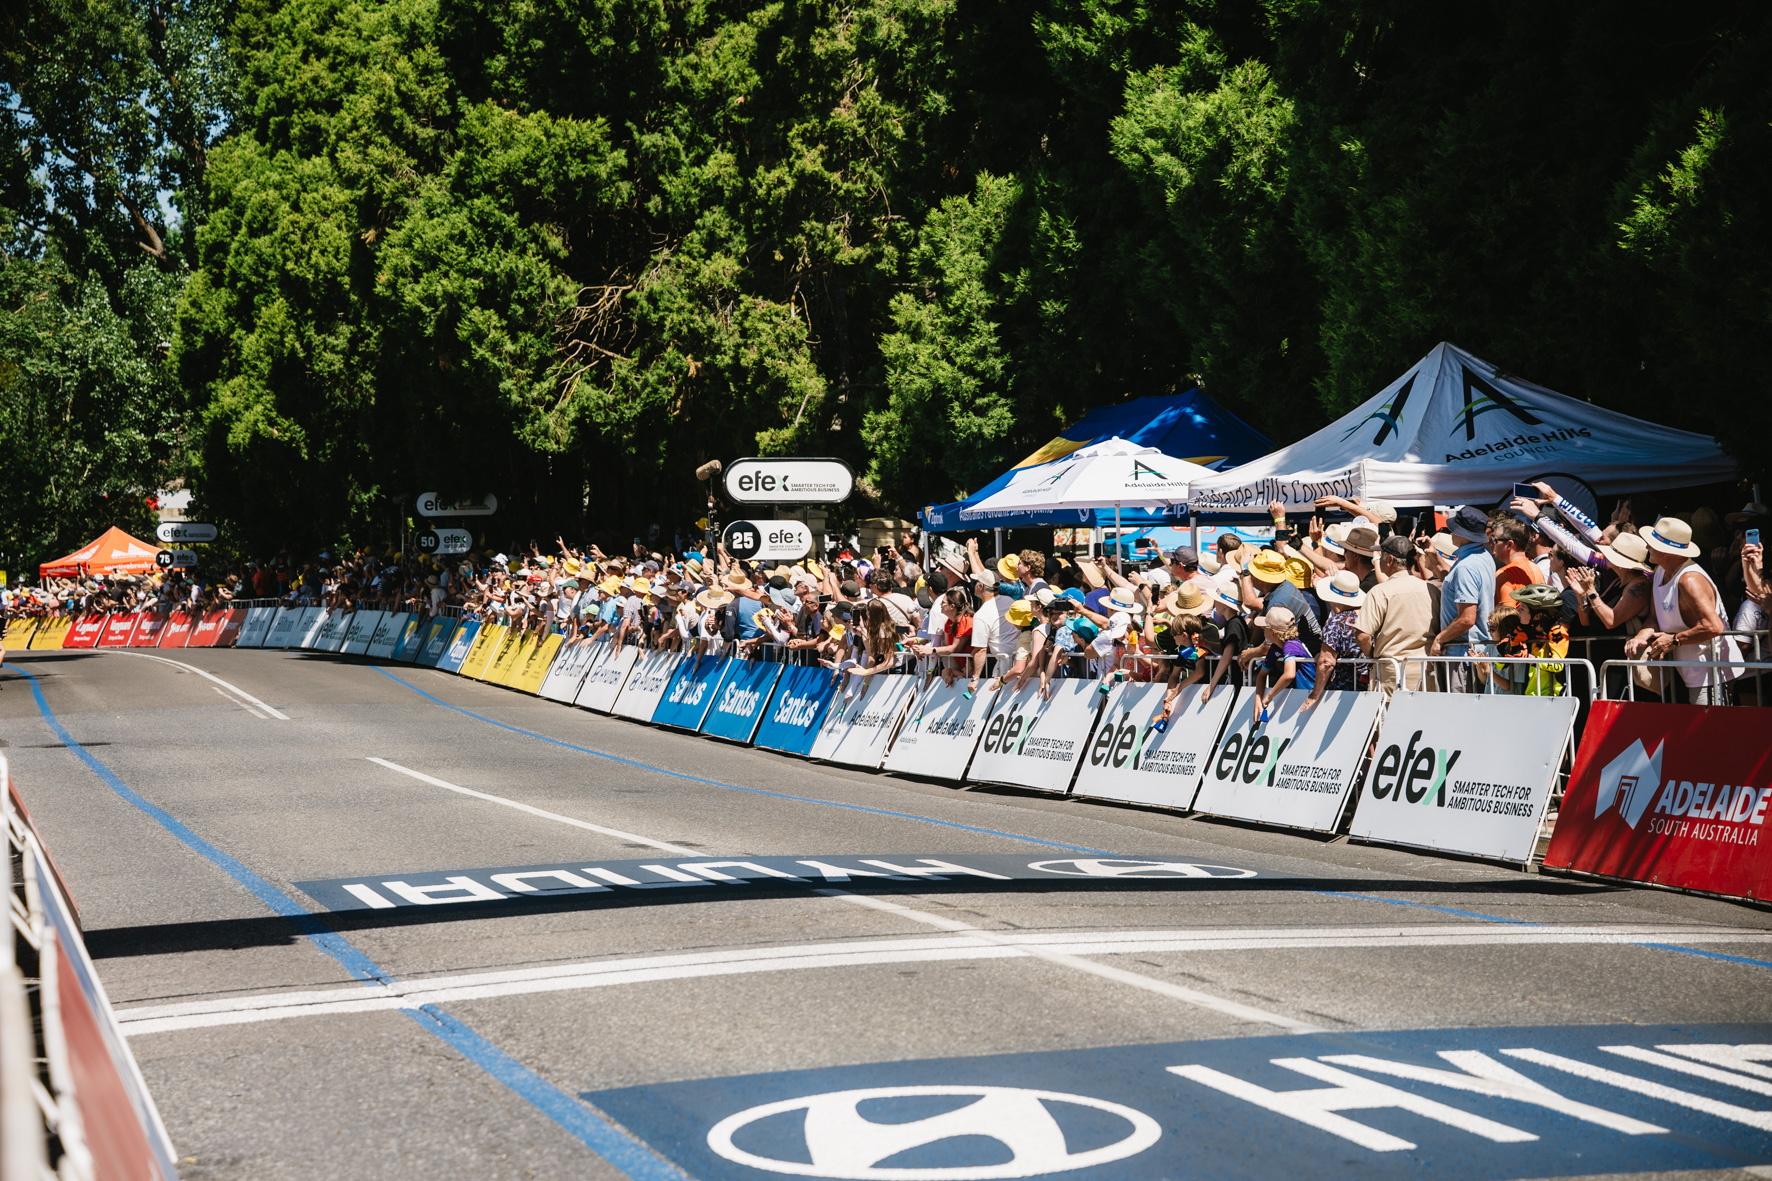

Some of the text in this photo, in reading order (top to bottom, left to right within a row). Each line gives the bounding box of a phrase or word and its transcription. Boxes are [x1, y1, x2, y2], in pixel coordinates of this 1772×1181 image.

[1446, 427, 1592, 463] Adelaide Hills
[1494, 445, 1560, 462] COUNCIL
[738, 470, 790, 492] efex
[1255, 477, 1288, 506] Hills
[1291, 470, 1353, 503] Council
[163, 527, 188, 538] efex
[421, 535, 435, 547] 50
[443, 534, 467, 544] efex
[732, 531, 754, 550] 25
[768, 529, 803, 544] efex
[160, 554, 171, 564] 75
[669, 674, 708, 706] Santos
[719, 681, 760, 717] Santos
[774, 689, 819, 727] Santos
[849, 710, 879, 728] Adelaide
[926, 717, 976, 737] Adelaide Hills
[983, 703, 1038, 756] efex
[1027, 736, 1075, 750] SMARTER TECH FOR
[1091, 711, 1155, 771] efex
[1023, 748, 1074, 762] AMBITIOUS BUSINESS
[1144, 750, 1196, 764] SMARTER TECH FOR
[1216, 720, 1291, 788] efex
[1140, 761, 1197, 776] AMBITIOUS BUSINESS
[1280, 764, 1342, 781] SMARTER TECH FOR
[1372, 729, 1462, 808] efex
[1275, 778, 1342, 795] AMBITIOUS BUSINESS
[1452, 780, 1532, 801] SMARTER TECH FOR
[1447, 795, 1534, 818] AMBITIOUS BUSINESS
[1654, 779, 1772, 825] ADELAIDE
[1648, 817, 1759, 846] SOUTH AUSTRALIA
